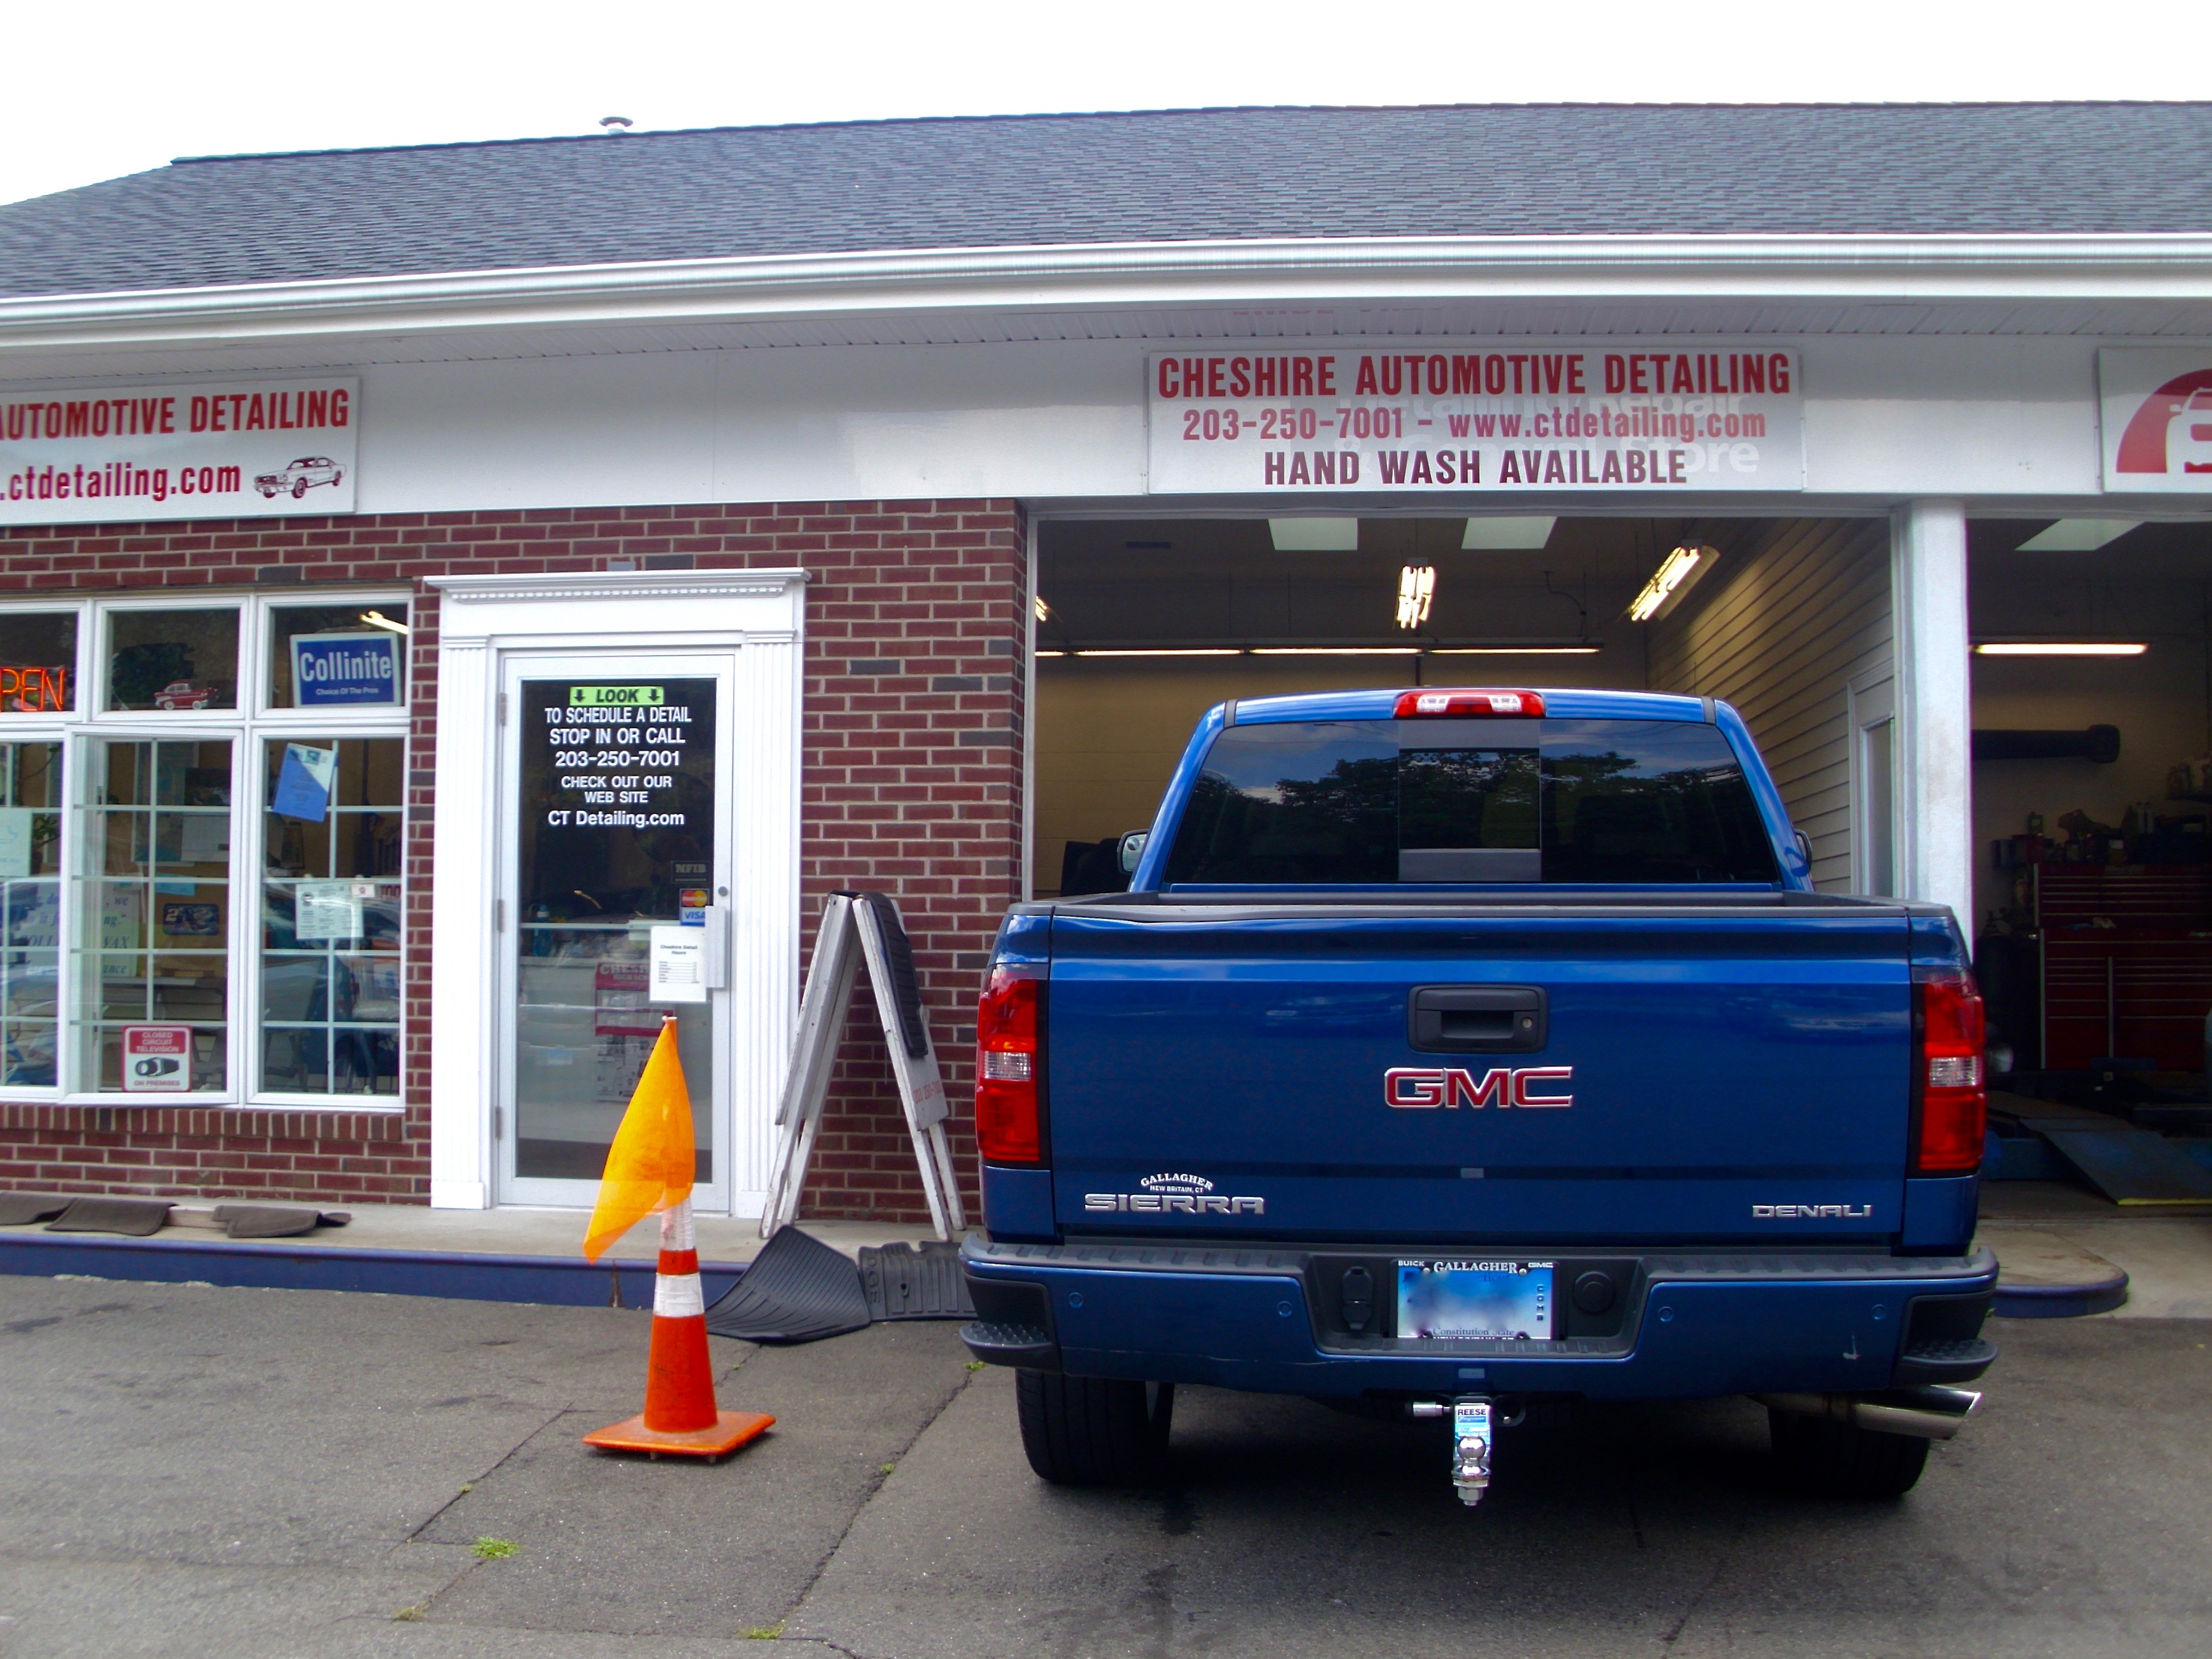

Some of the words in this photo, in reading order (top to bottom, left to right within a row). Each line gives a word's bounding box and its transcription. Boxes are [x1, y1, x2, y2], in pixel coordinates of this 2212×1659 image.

[1159, 356, 1336, 398] CHESHIRE
[1356, 354, 1586, 396] AUTOMOTIVE
[1605, 353, 1790, 394] DETAILING
[190, 389, 349, 432] DETAILING
[1183, 407, 1402, 441] 203-250-7001
[1448, 406, 1766, 444] www.ctdetailing.com
[1264, 451, 1360, 485] HAND
[1377, 450, 1480, 484] WASH
[1499, 449, 1687, 484] AVAILABLE
[300, 650, 392, 682] Collinite
[596, 688, 639, 703] LOOK
[545, 707, 561, 723] TO
[566, 707, 632, 723] SCHEDULE
[635, 707, 645, 723] A
[650, 706, 692, 723] DETAIL
[549, 728, 590, 744] STOP
[596, 728, 611, 744] IN
[617, 728, 639, 744] OR
[646, 727, 686, 744] CALL
[555, 750, 680, 767] 203-250-7001
[561, 776, 607, 788] CHECK
[611, 776, 639, 788] OUT
[643, 776, 672, 788] OUR
[585, 791, 614, 803] WEB
[619, 791, 648, 803] SITE
[548, 811, 570, 826] CT
[575, 811, 684, 828] Detailing.com
[1384, 1066, 1573, 1108] GMC
[1141, 1173, 1213, 1190] GALLAGHER
[1085, 1193, 1264, 1214] SIERRA
[1752, 1205, 1871, 1218] DENALI
[1433, 1261, 1517, 1274] GALLAGHER
